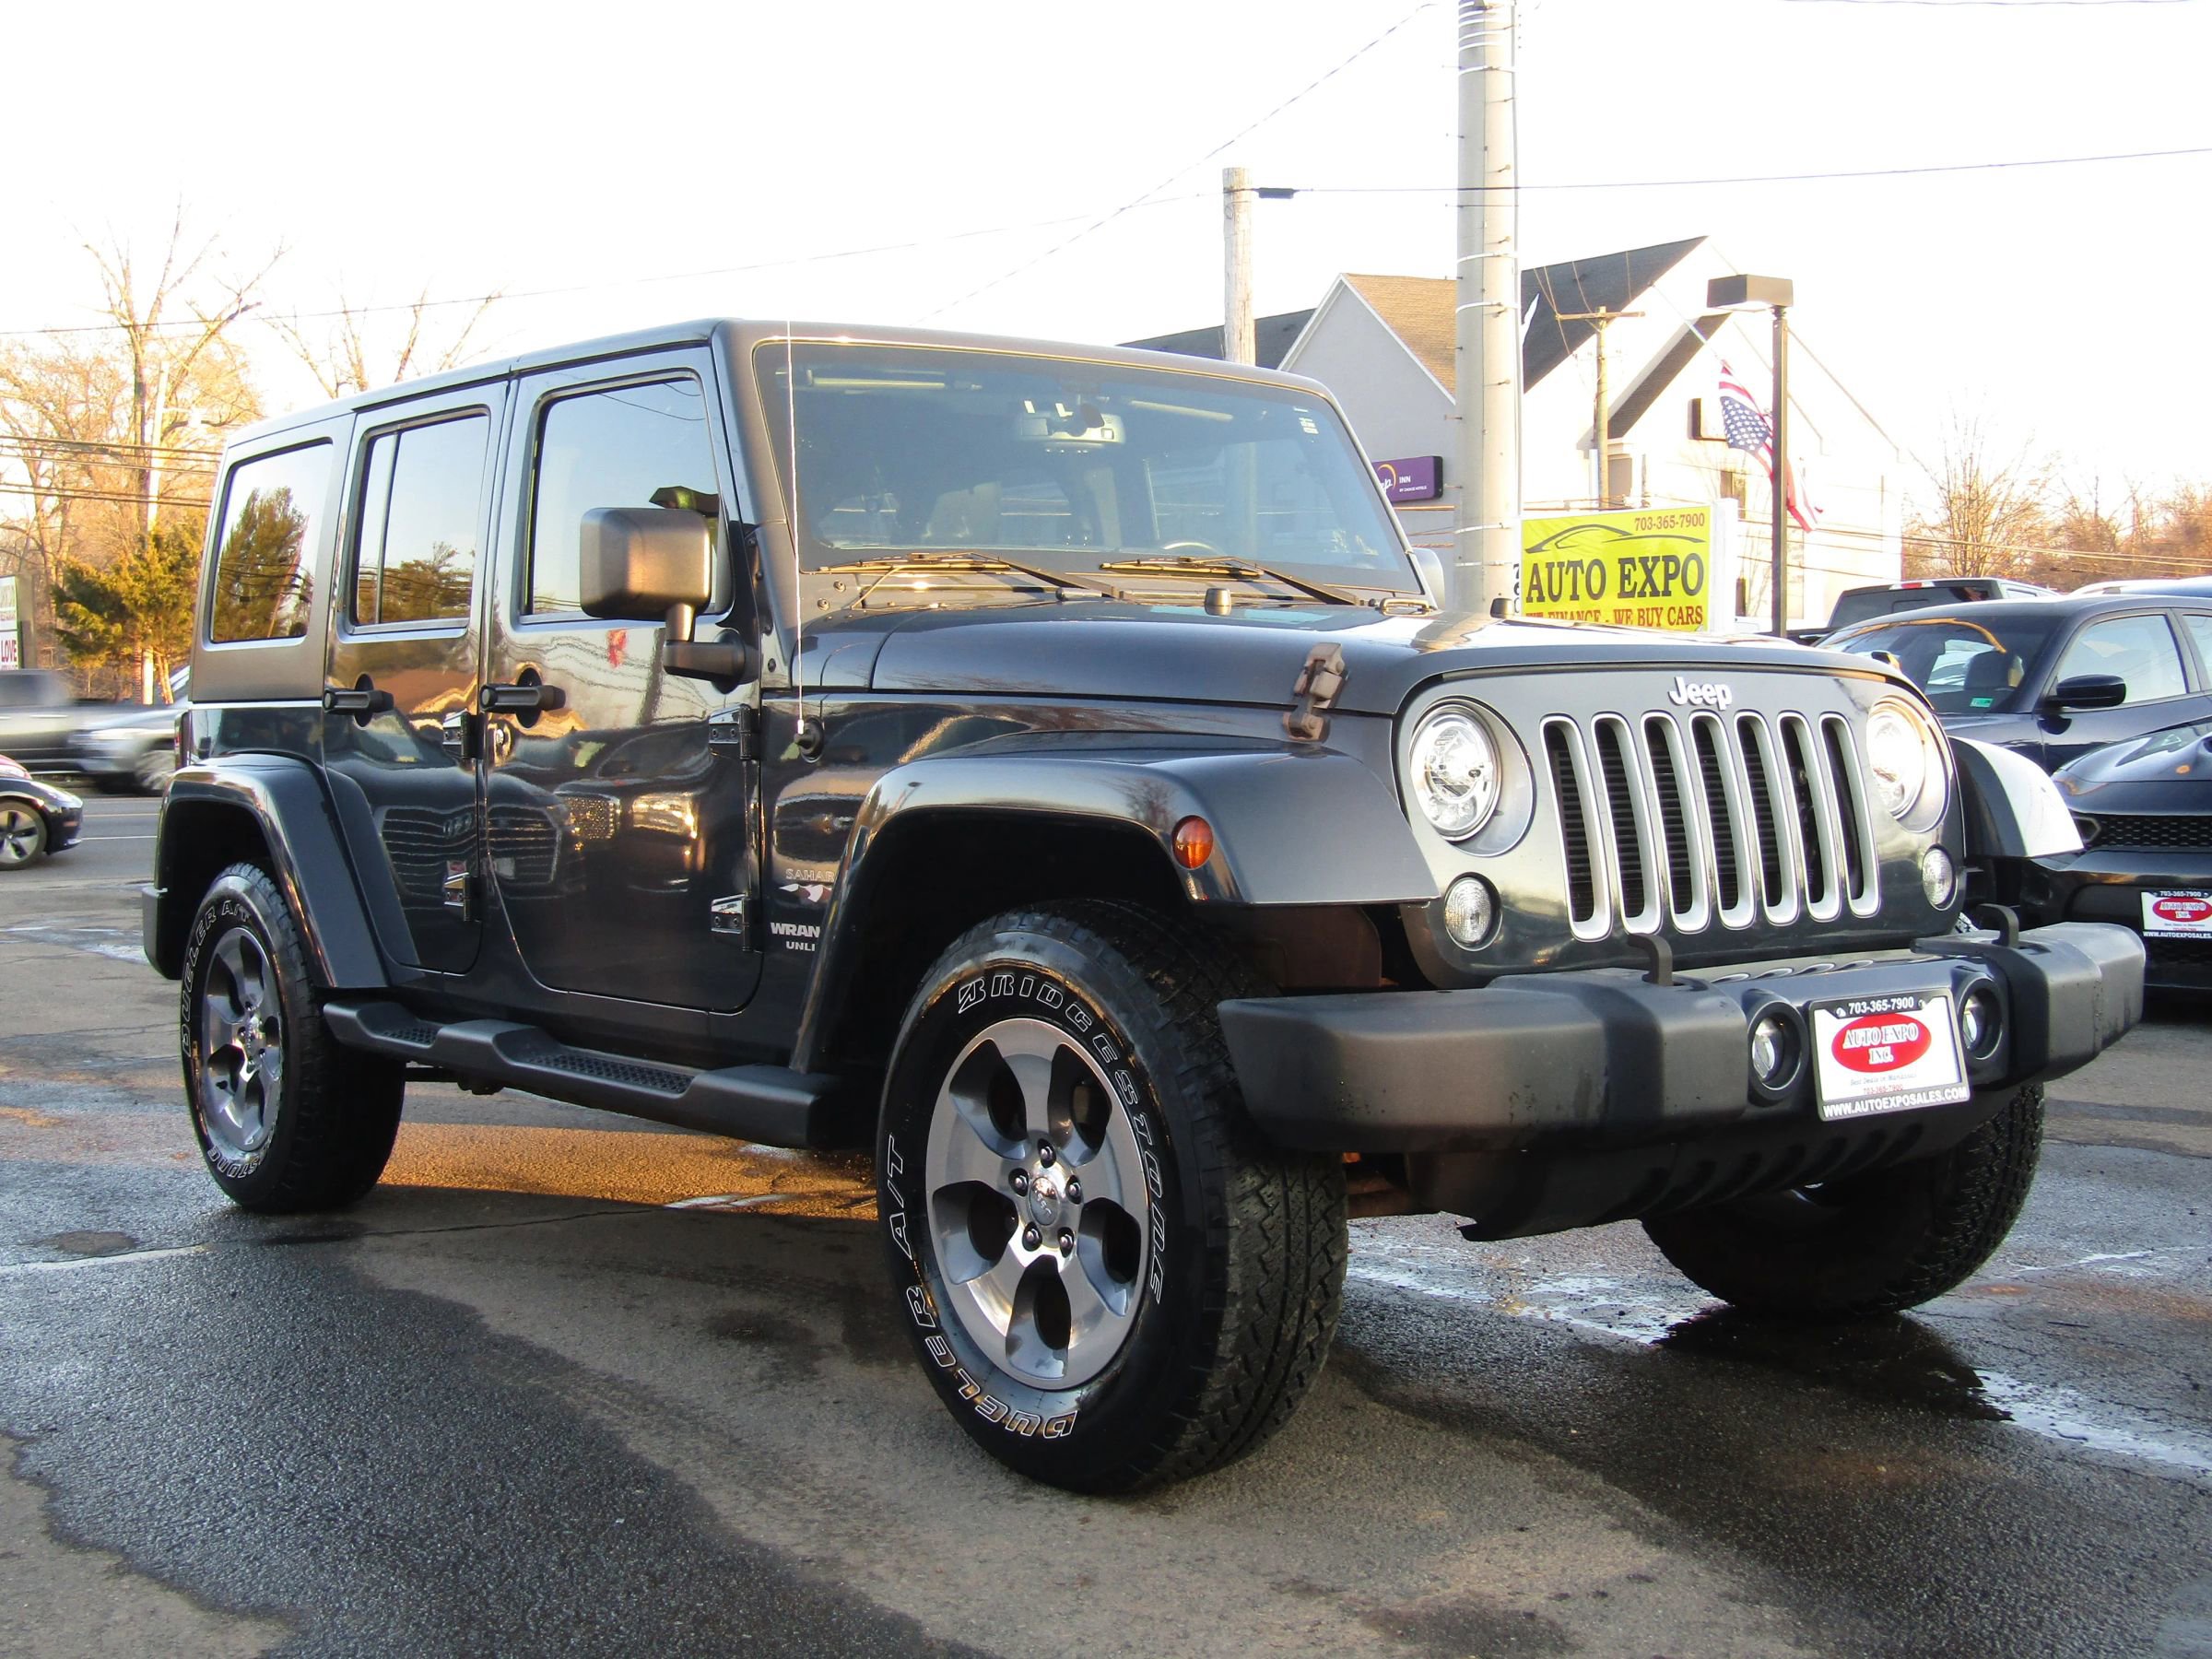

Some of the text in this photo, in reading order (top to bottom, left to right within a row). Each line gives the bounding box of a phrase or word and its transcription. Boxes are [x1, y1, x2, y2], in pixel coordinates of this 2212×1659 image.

[1399, 476, 1411, 484] INN
[1634, 512, 1705, 531] 703-365-7900
[1525, 553, 1704, 603] AUTO EXPO
[1613, 608, 1632, 625] WE
[1637, 607, 1663, 627] BUY
[1667, 606, 1703, 626] CARS
[1667, 676, 1733, 712] Jeep
[1848, 996, 1914, 1014] 703-365-7900
[1842, 1022, 1920, 1050] AUTO EXPO
[1868, 1046, 1895, 1065] INC.
[1823, 1087, 1967, 1117] WWW.AUTOEXPOSALES.COM
[958, 973, 1165, 1304] BRIDGESTONE
[885, 1134, 1077, 1438] DUELER A/T
